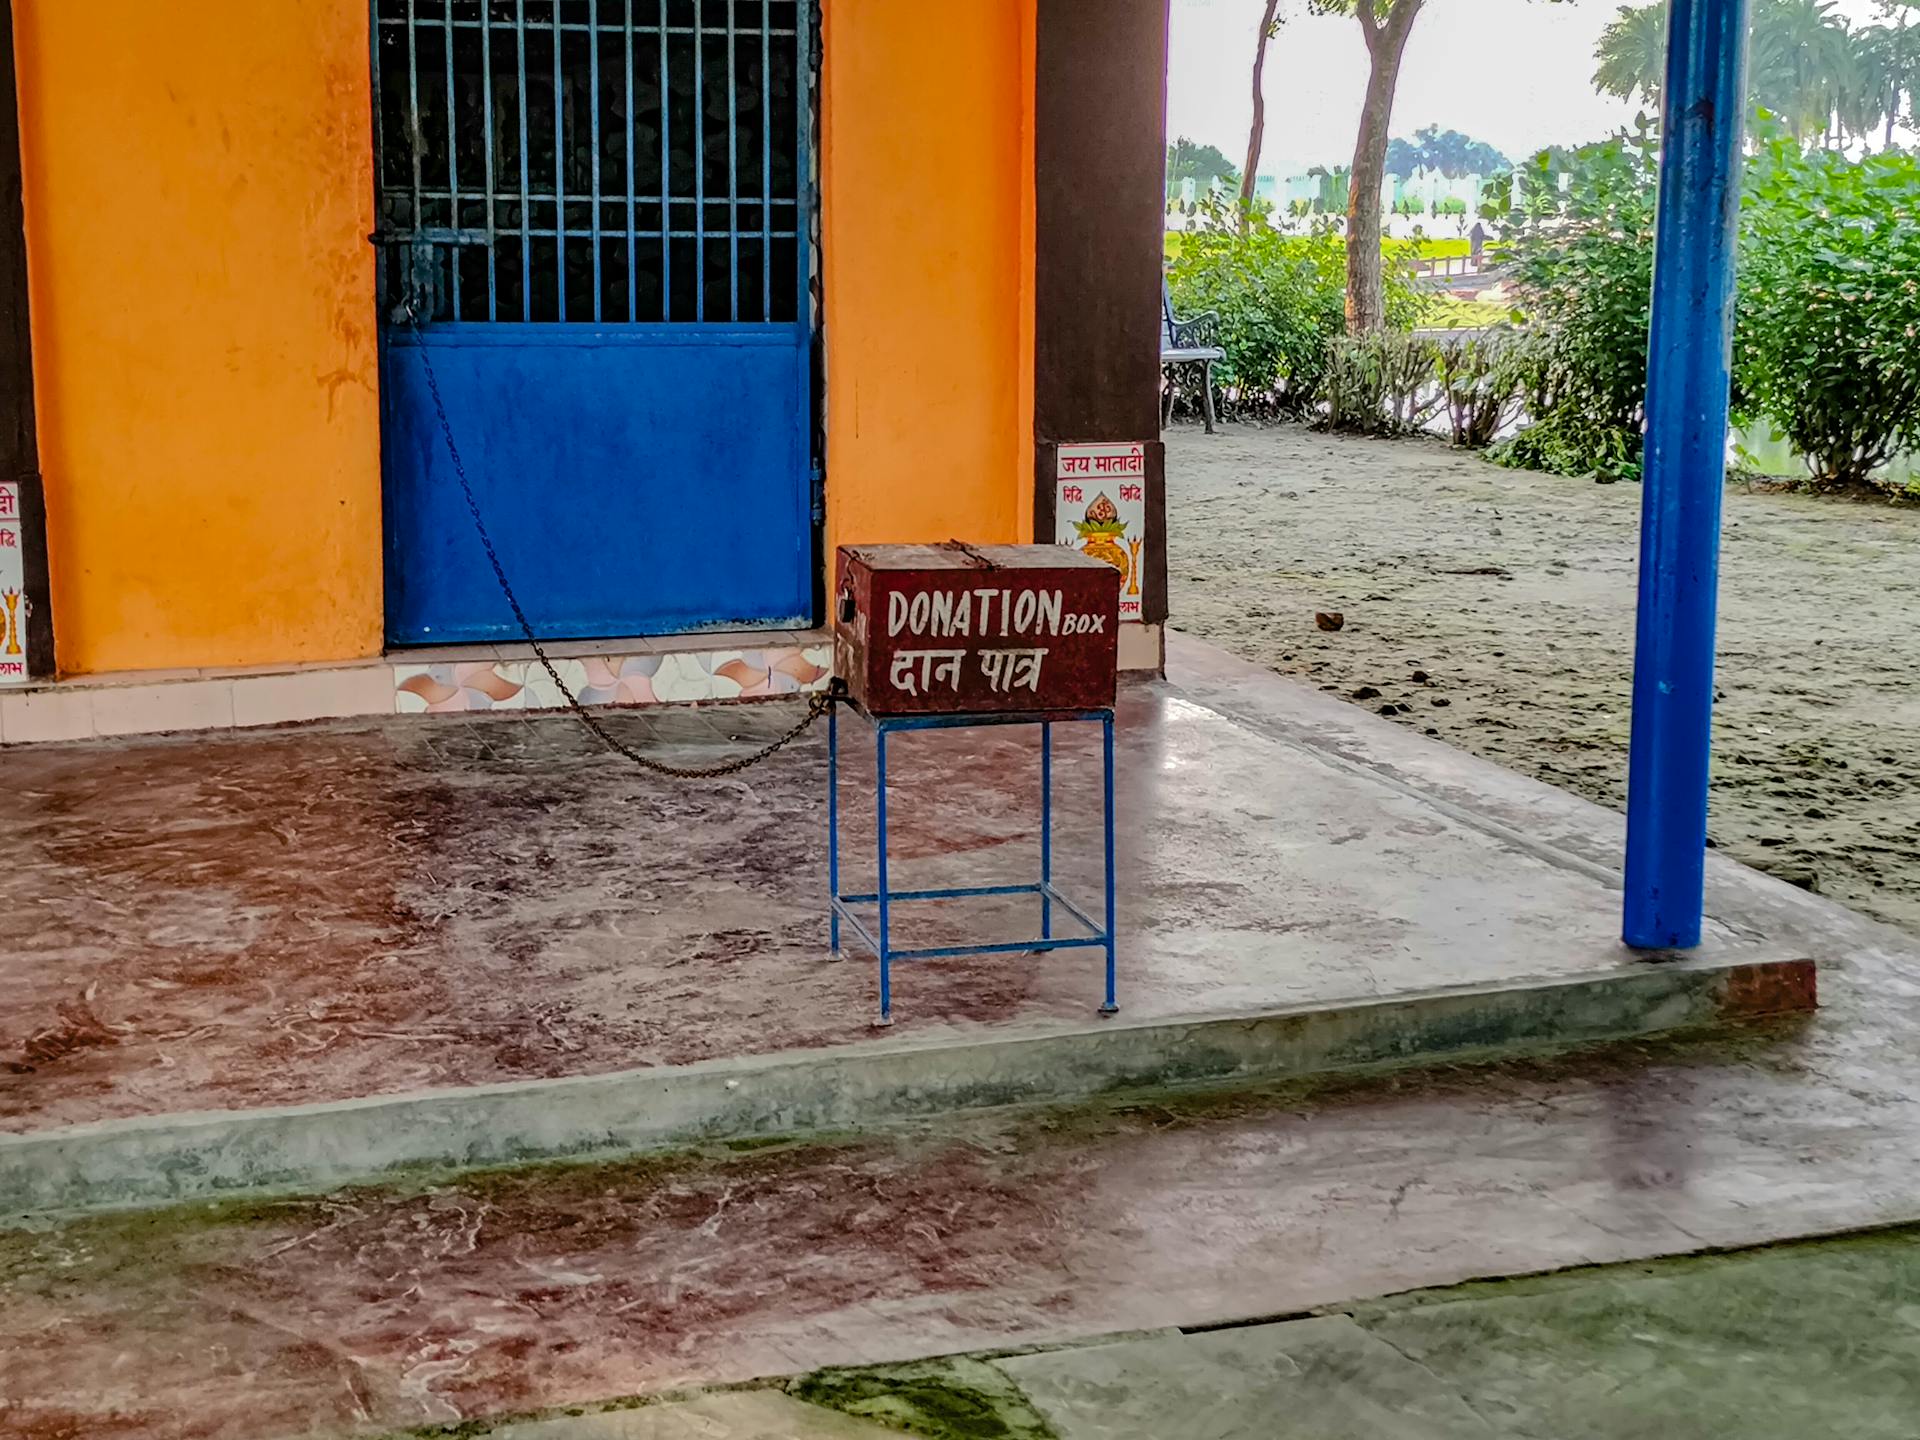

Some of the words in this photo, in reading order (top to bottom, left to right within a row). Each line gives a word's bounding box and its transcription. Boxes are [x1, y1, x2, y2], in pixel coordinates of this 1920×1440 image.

[1061, 457, 1091, 474] जय
[887, 588, 1063, 637] DONATION
[1062, 613, 1107, 636] BOX
[889, 649, 967, 697] दान
[977, 648, 1050, 693] पात्र
